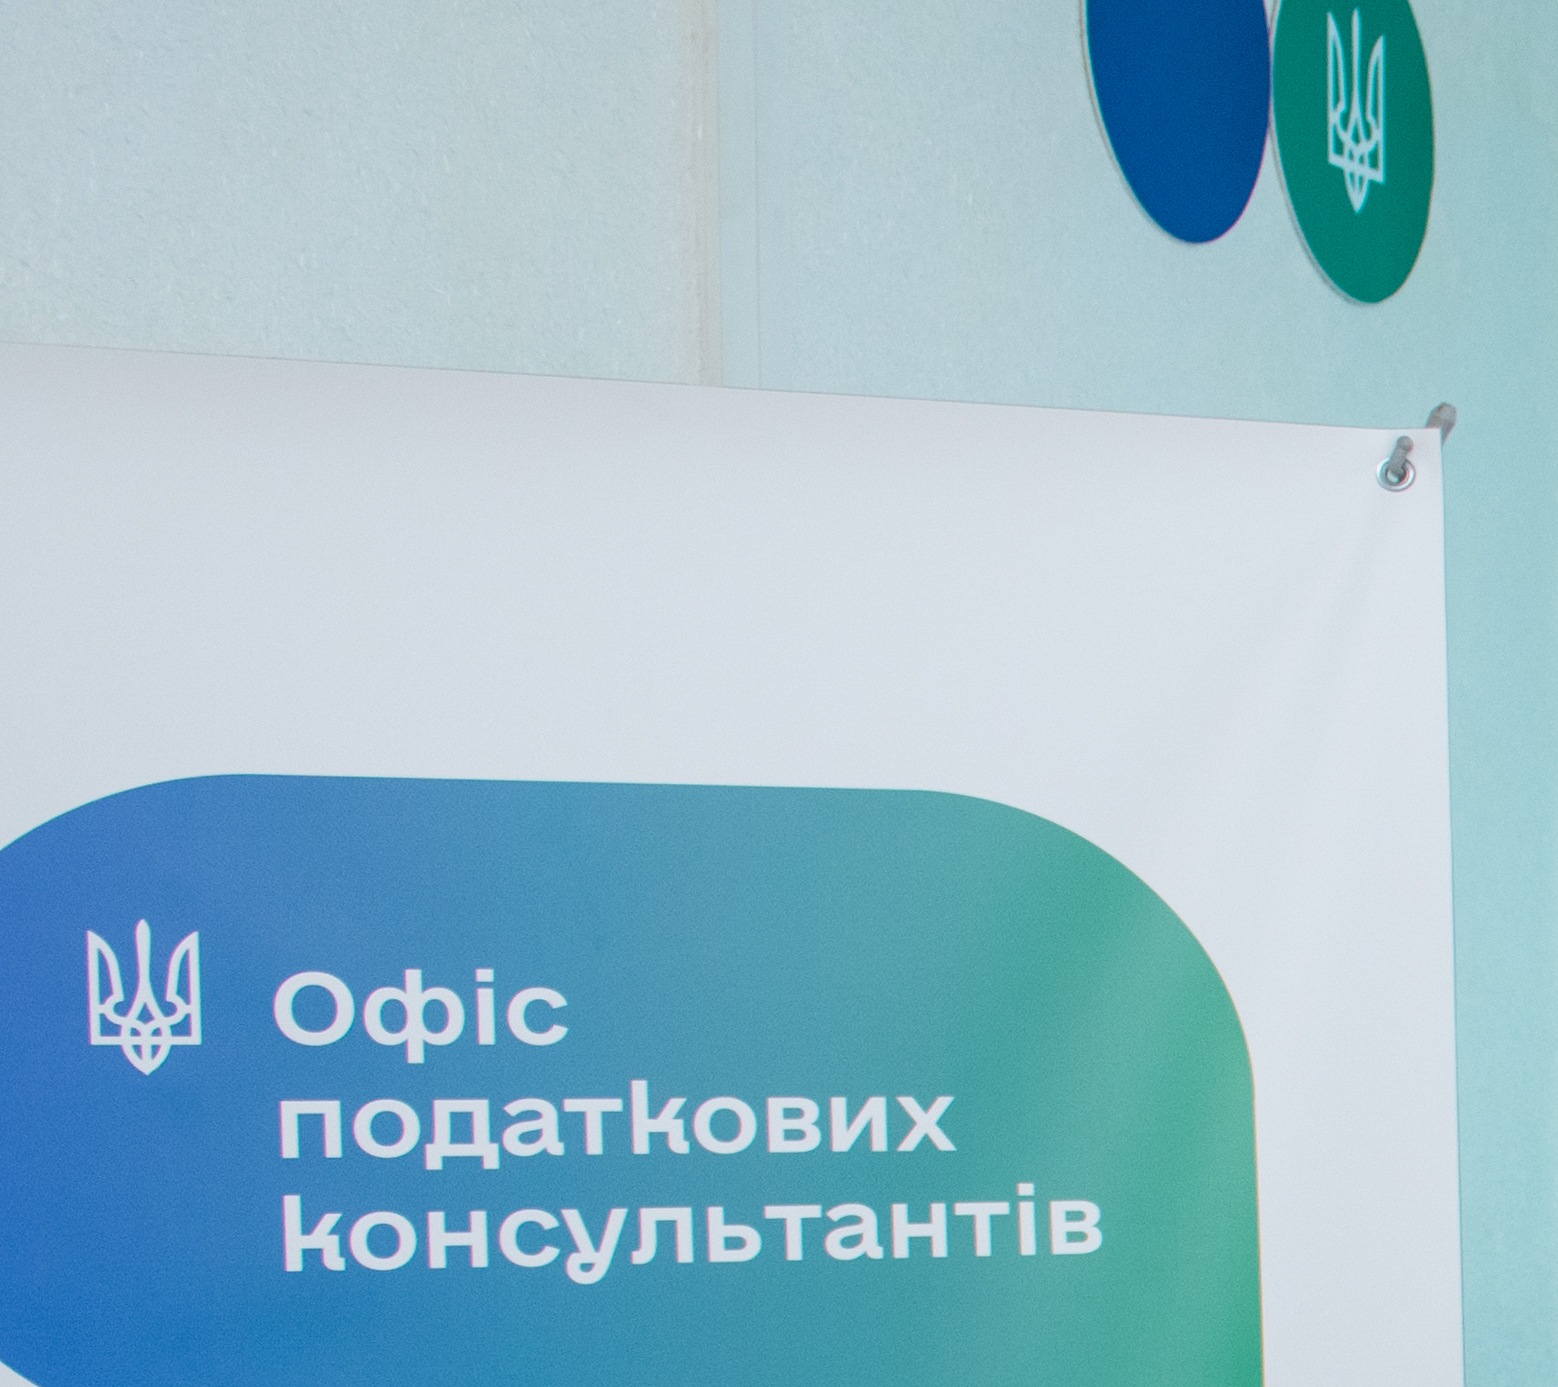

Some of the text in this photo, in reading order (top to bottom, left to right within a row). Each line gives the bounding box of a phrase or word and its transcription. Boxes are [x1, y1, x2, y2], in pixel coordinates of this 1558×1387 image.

[273, 968, 569, 1064] Офіс
[279, 1079, 956, 1171] податкових
[282, 1184, 1104, 1285] консультантів
